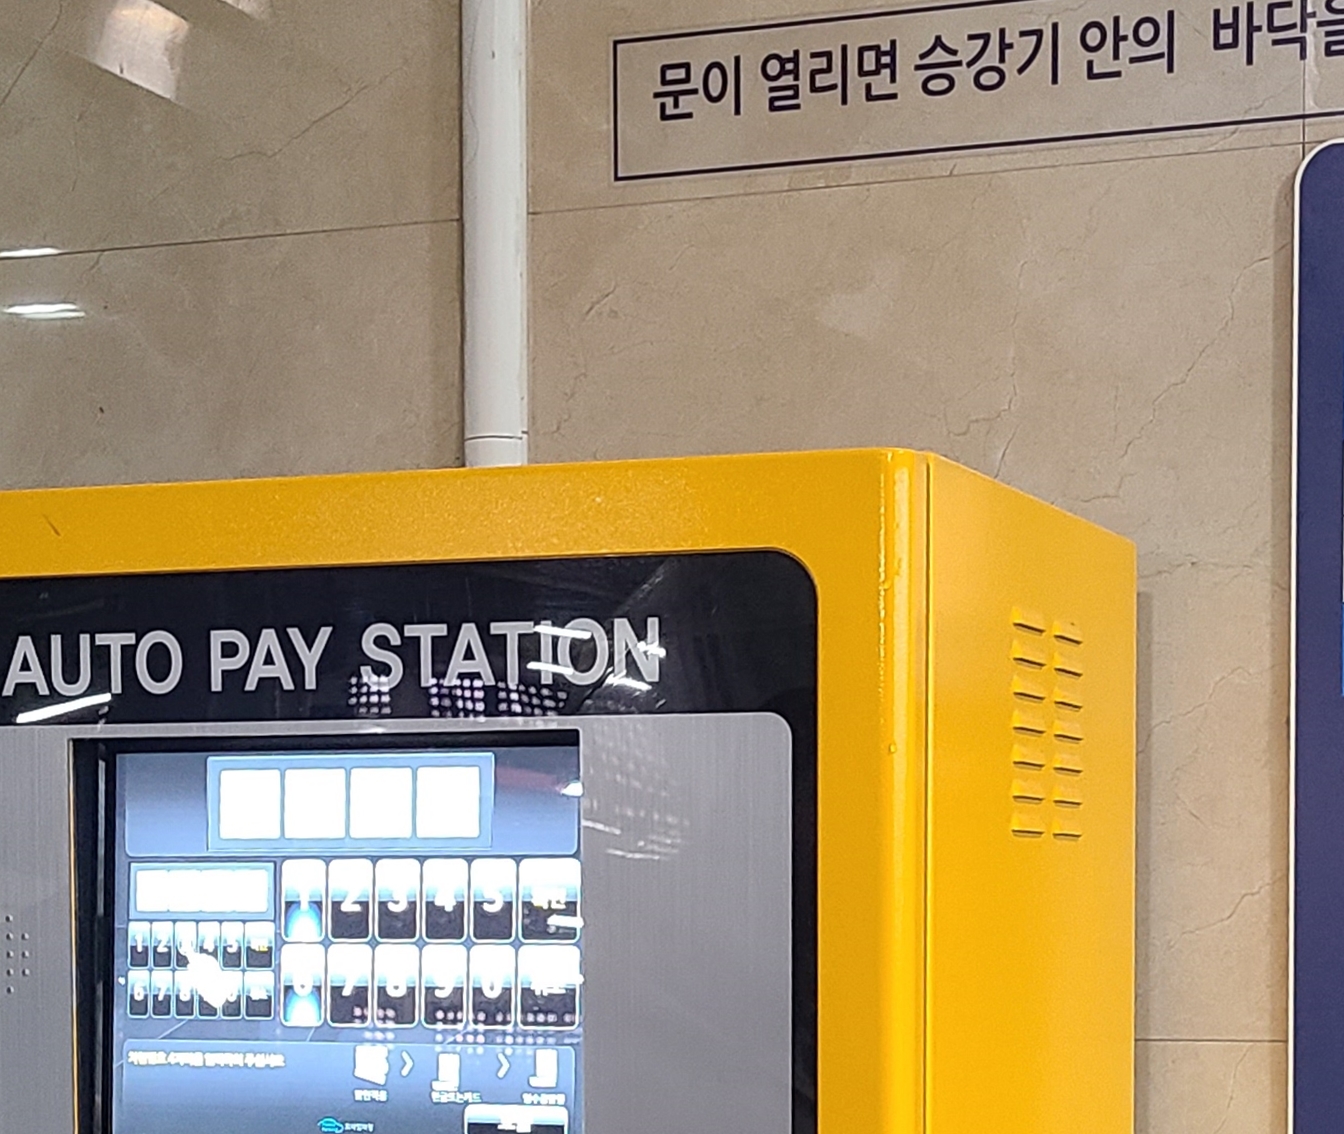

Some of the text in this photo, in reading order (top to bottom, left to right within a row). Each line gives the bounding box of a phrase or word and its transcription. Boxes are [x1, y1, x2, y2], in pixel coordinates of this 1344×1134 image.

[652, 55, 741, 121] 문이
[760, 38, 898, 112] 열리면
[913, 21, 1058, 96] 승강기
[1079, 9, 1174, 80] 안의
[2, 617, 660, 696] AUTO PAY STATION
